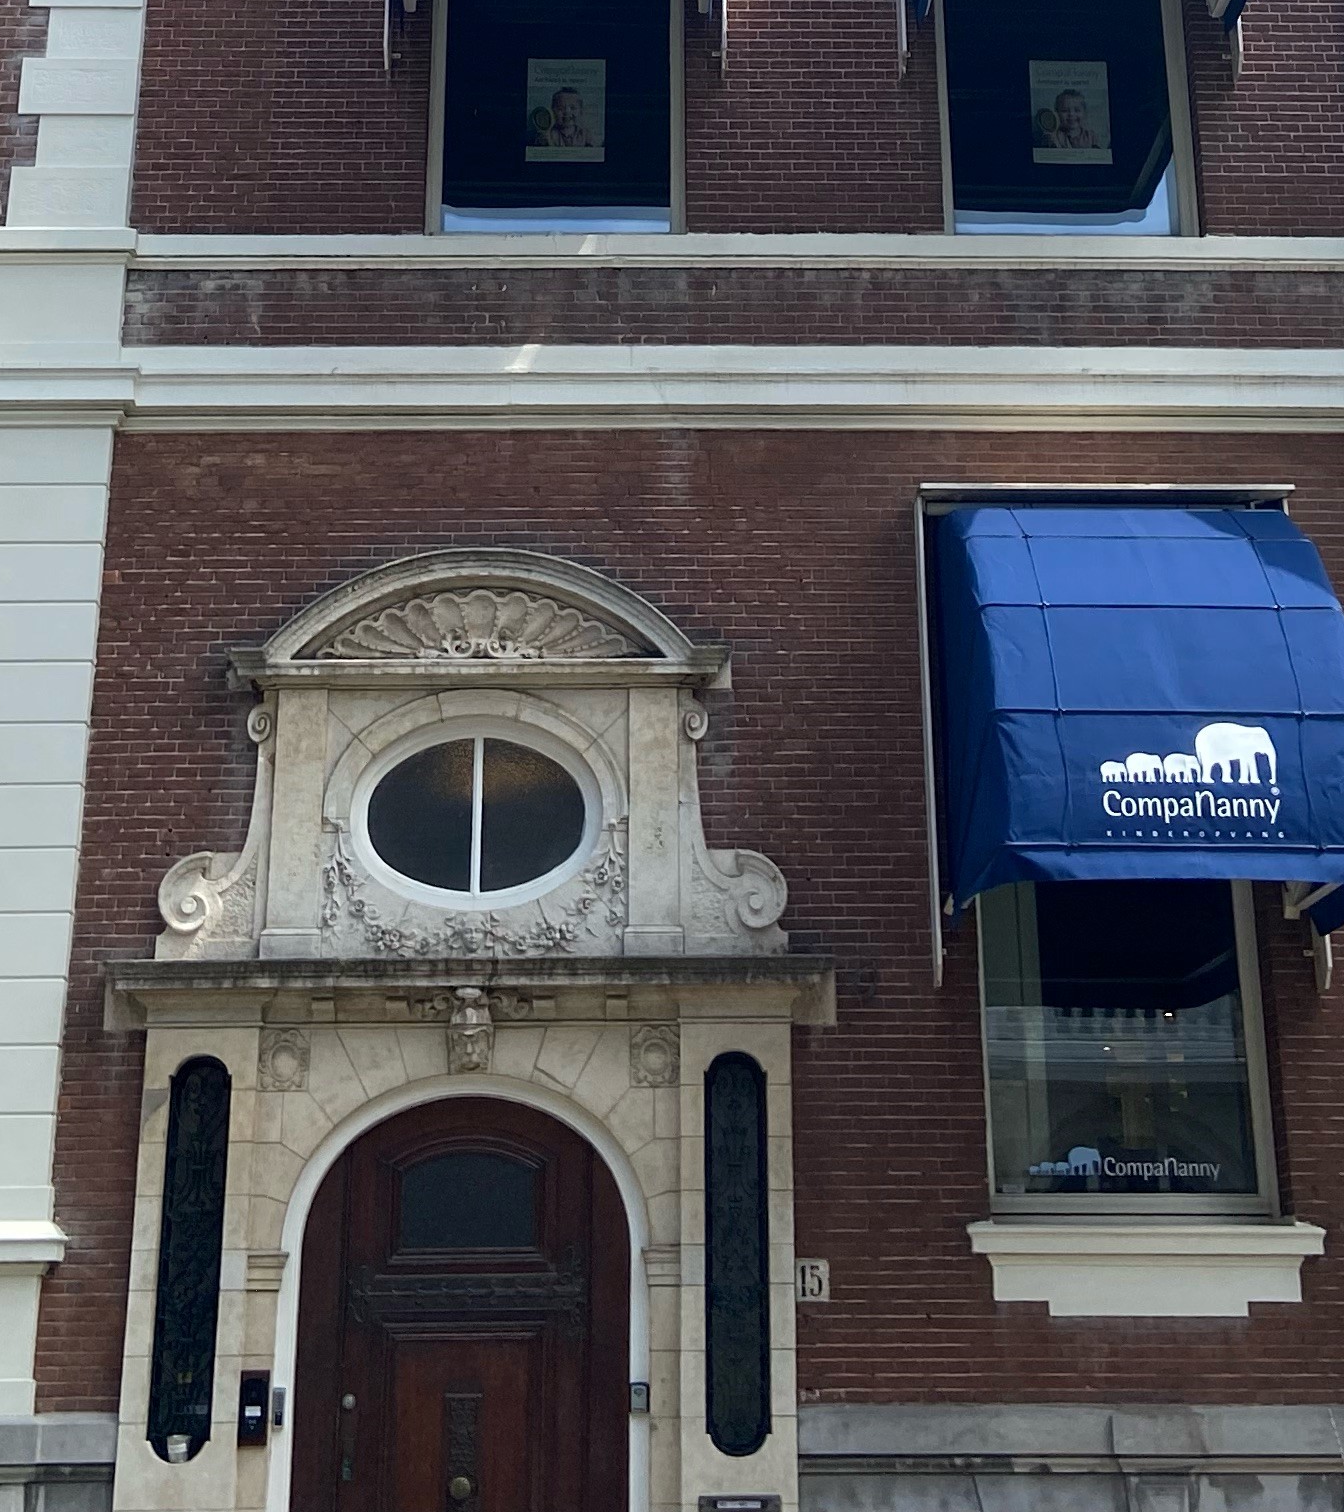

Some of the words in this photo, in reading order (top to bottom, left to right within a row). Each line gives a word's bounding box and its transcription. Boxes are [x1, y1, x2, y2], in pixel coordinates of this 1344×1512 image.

[1102, 790, 1281, 824] CompaNanny
[1104, 1157, 1221, 1181] CompaNanny
[800, 1265, 823, 1297] 15
